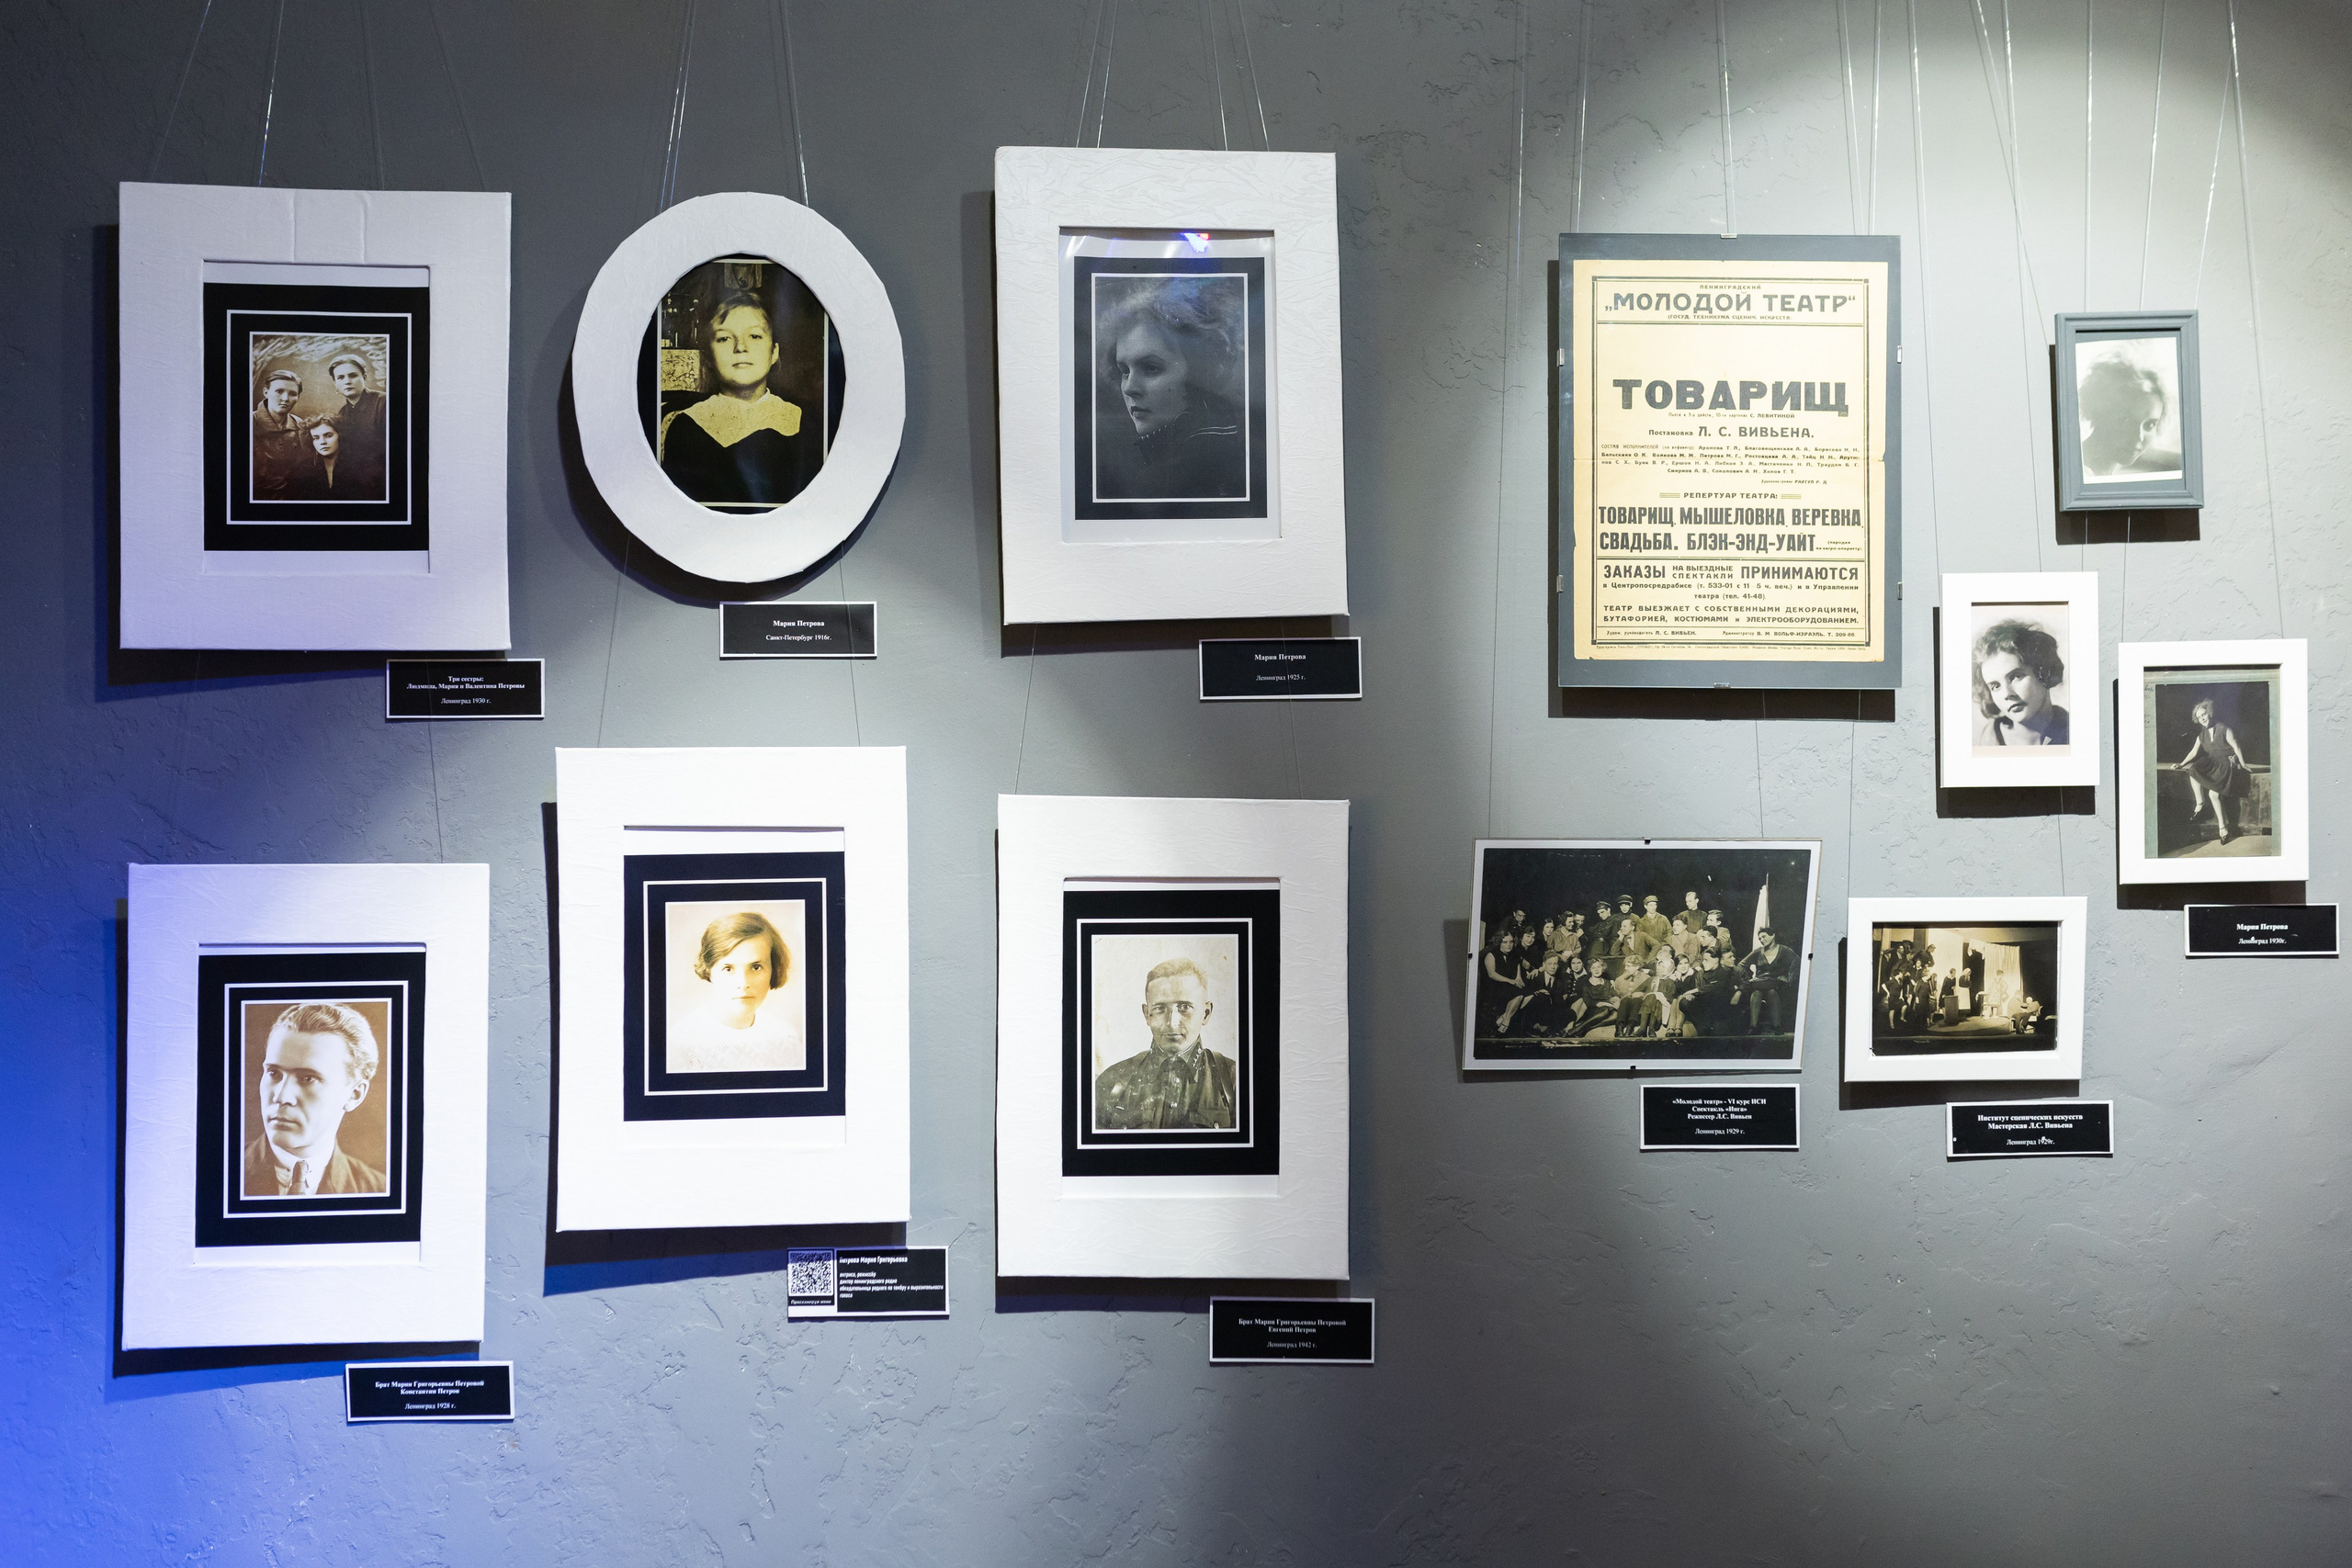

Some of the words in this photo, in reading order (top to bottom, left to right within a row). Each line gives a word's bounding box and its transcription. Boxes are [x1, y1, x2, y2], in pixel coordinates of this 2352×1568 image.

[1612, 379, 1849, 417] ТОВАРИЩ
[1698, 426, 1711, 437] Л.
[1718, 426, 1732, 437] С.
[1738, 426, 1815, 438] ВИВЬЕНА.
[1600, 531, 1679, 553] СВАДЬБА.
[1687, 532, 1816, 554] БЛЭК-ЭНД-УАЙТ
[1603, 564, 1666, 579] ЗАКАЗЫ
[1741, 566, 1859, 581] ПРИНИМАЮТСЯ
[1785, 606, 1859, 615] ДЕКОРАЦИЯМИ,
[1603, 615, 1668, 623] БУТАФОРИЕЙ,
[1746, 616, 1859, 625] ЭЛЕКТРООБОРУДОВАНИЕМ.
[860, 1256, 877, 1264] Мария
[877, 1256, 908, 1264] Григорьевна
